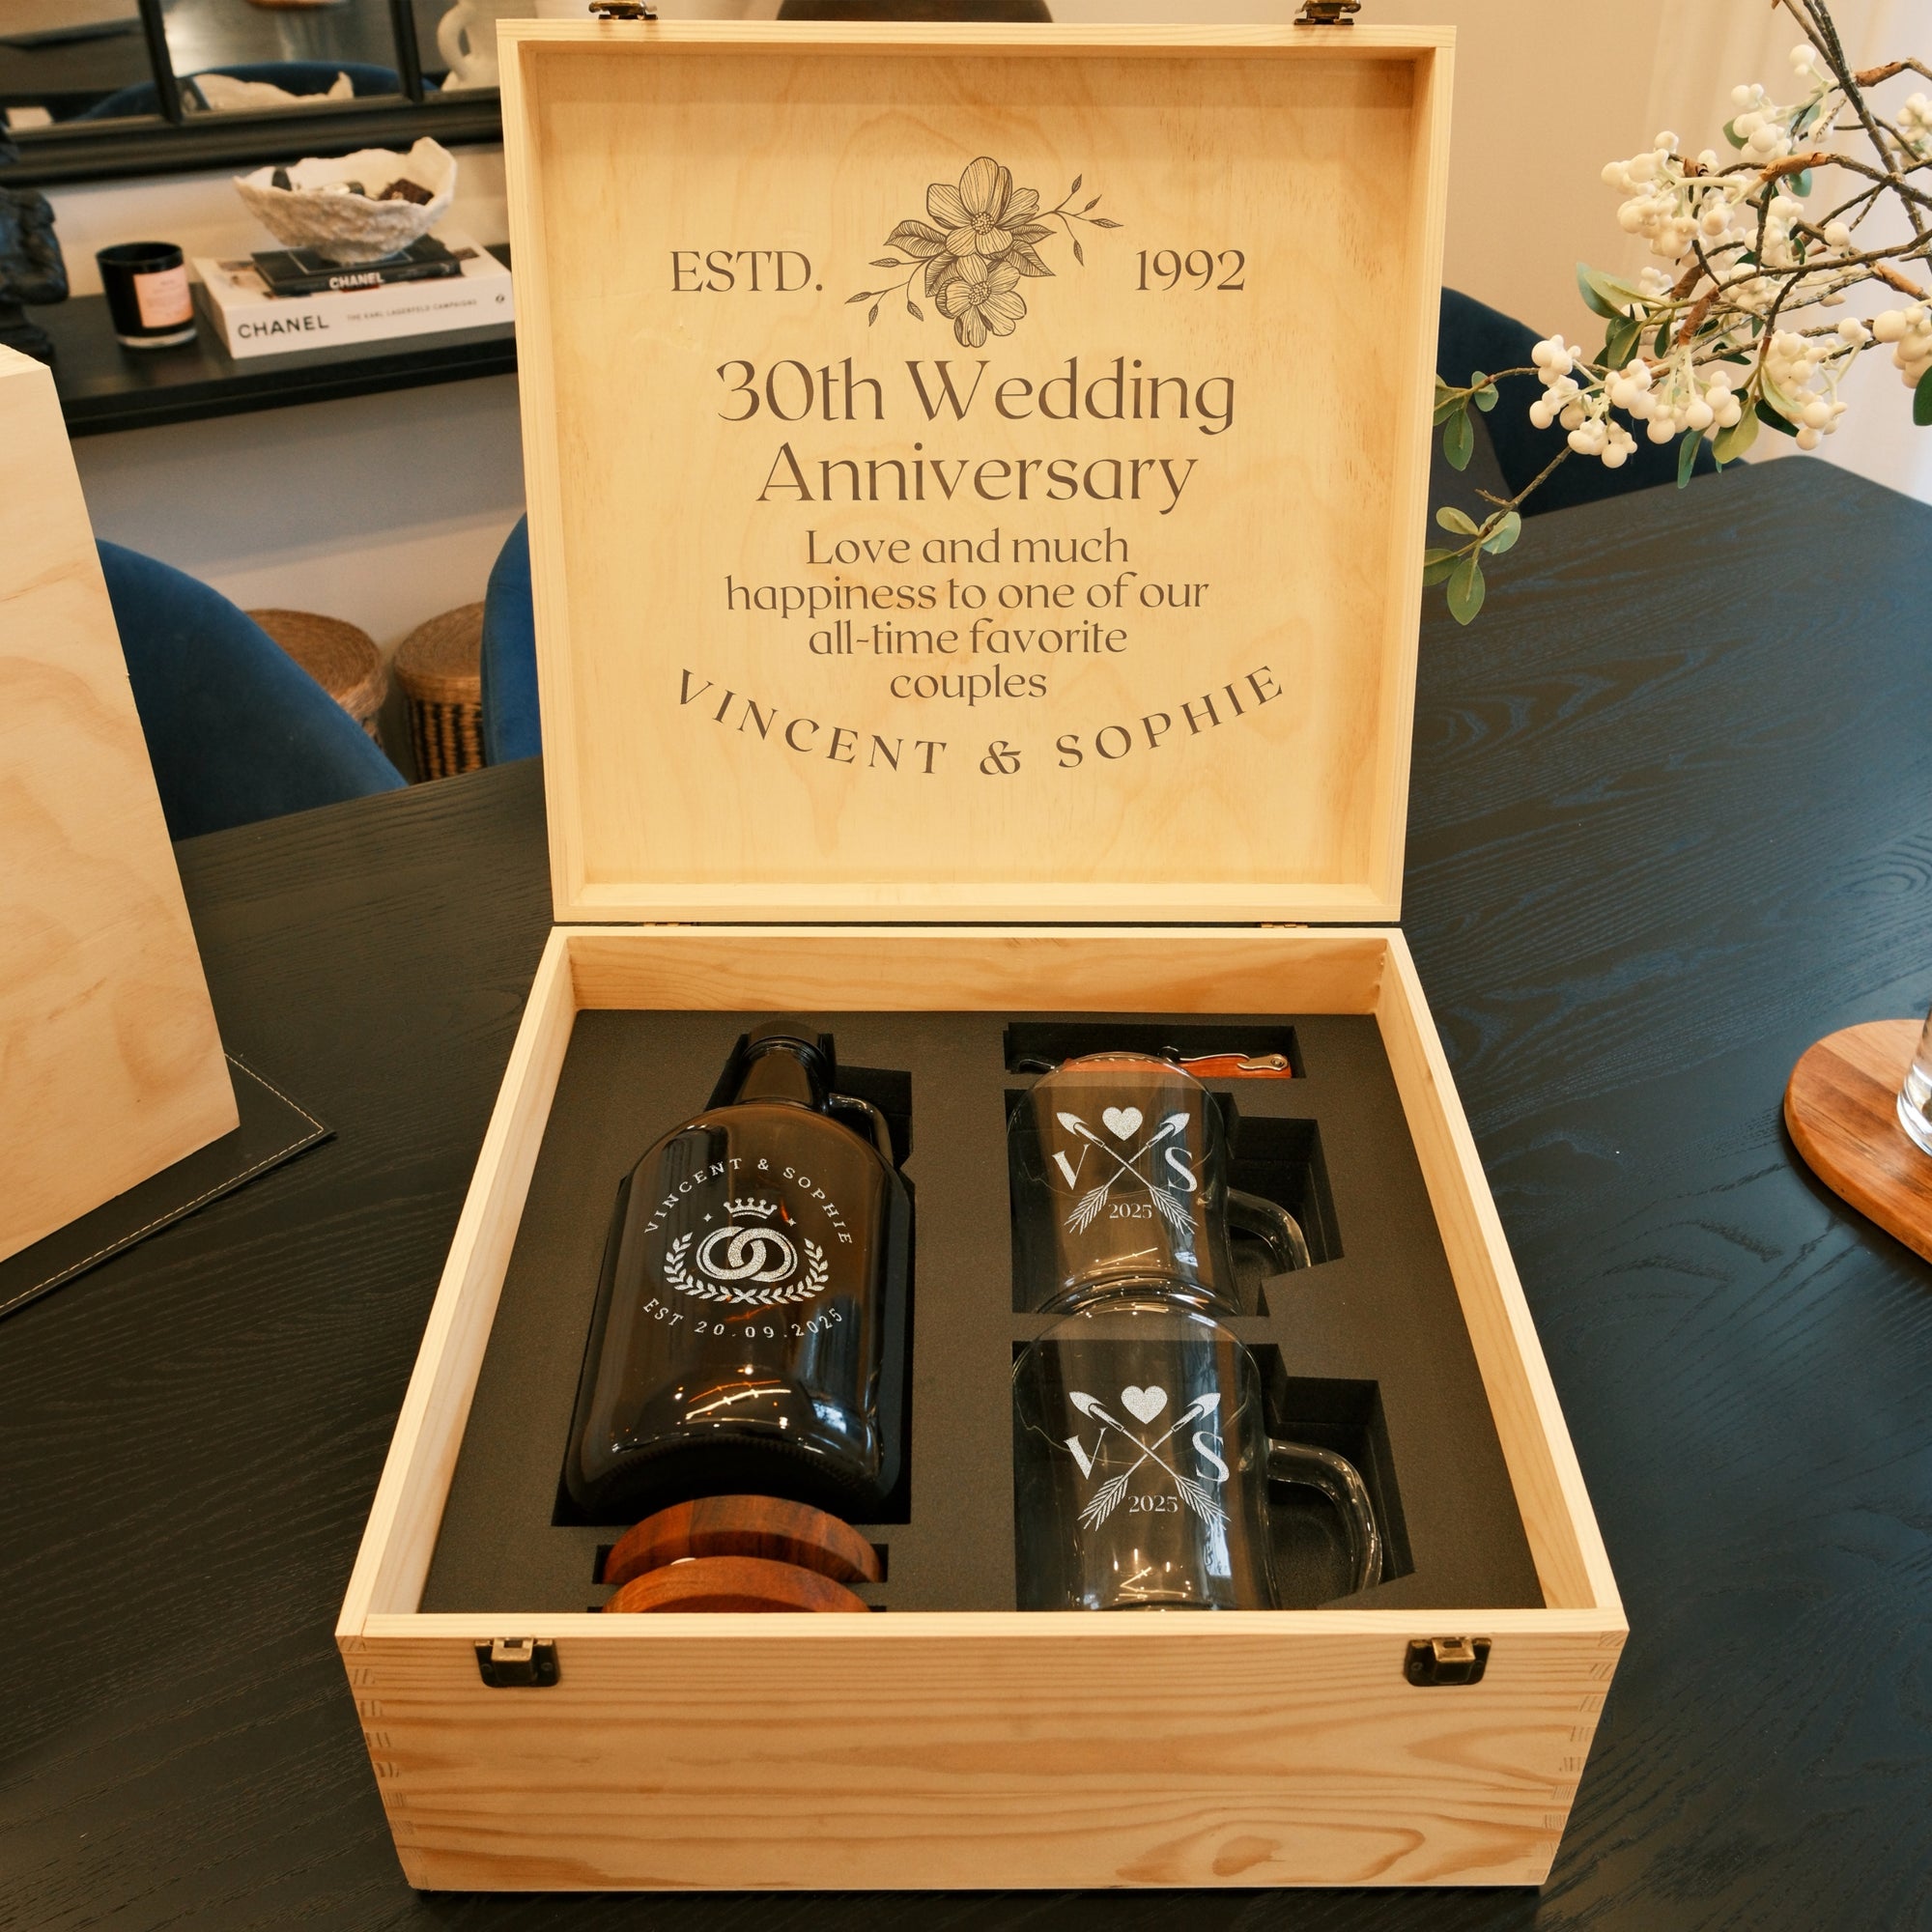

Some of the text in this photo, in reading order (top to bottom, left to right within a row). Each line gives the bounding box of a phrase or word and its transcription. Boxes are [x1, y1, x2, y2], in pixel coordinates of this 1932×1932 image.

[328, 271, 385, 290] CHANEL
[670, 250, 823, 293] ESTD.
[1135, 249, 1245, 292] 1992
[238, 315, 329, 339] CHANEL
[717, 355, 1236, 436] 30th Wedding
[756, 441, 1198, 515] Anniversary
[806, 527, 1128, 564] Love and much
[724, 572, 1209, 618] happiness to one of our
[809, 617, 1127, 654] all-time favorite
[890, 663, 1047, 707] couples
[678, 665, 1284, 776] VINCENT & SOPHIE
[1052, 1143, 1198, 1192] V S
[644, 1157, 852, 1244] VINCENT & SOPHIE
[1108, 1203, 1152, 1219] 2025
[642, 1297, 843, 1339] EST 20.09.2025
[1064, 1427, 1230, 1483] V S
[1128, 1494, 1179, 1514] 2025
